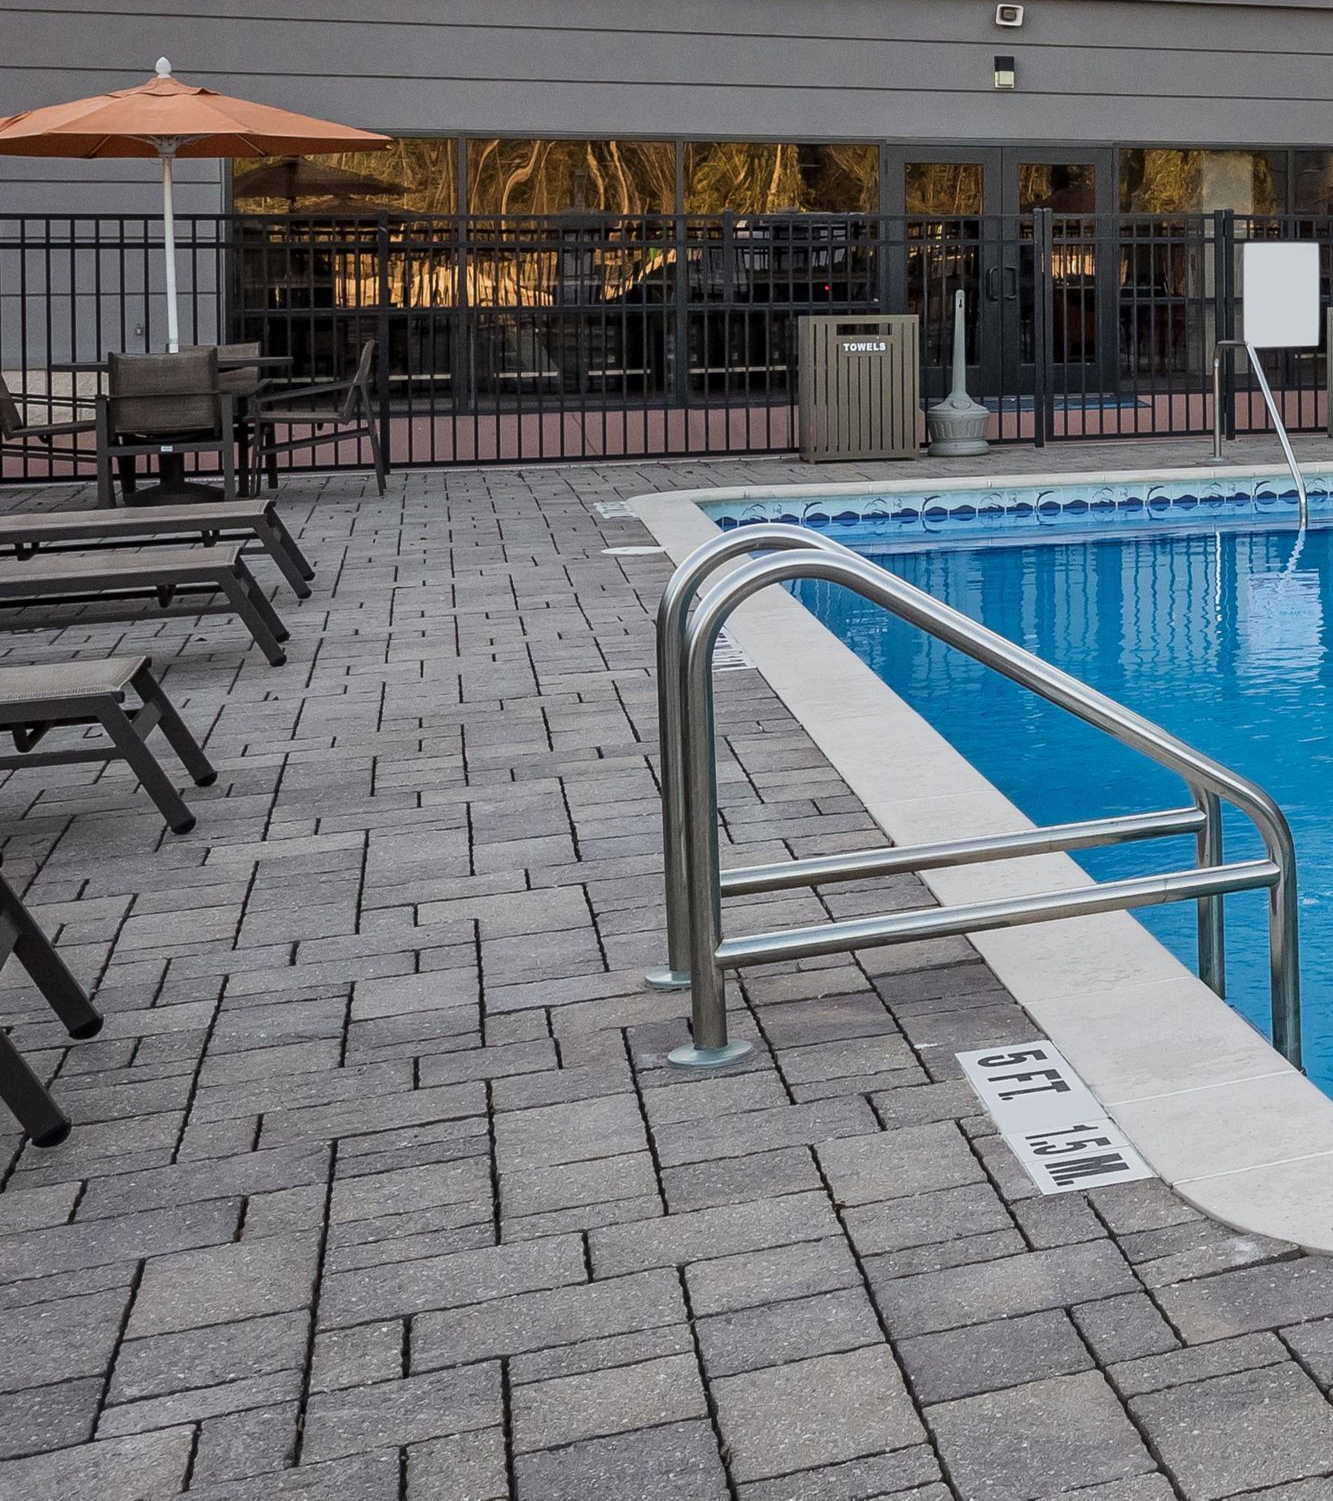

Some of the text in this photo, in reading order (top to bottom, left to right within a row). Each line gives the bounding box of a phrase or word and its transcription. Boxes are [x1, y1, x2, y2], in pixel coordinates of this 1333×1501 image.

[843, 342, 886, 352] TOWELS
[977, 1049, 1130, 1187] 5 FT. 1.5 M.
